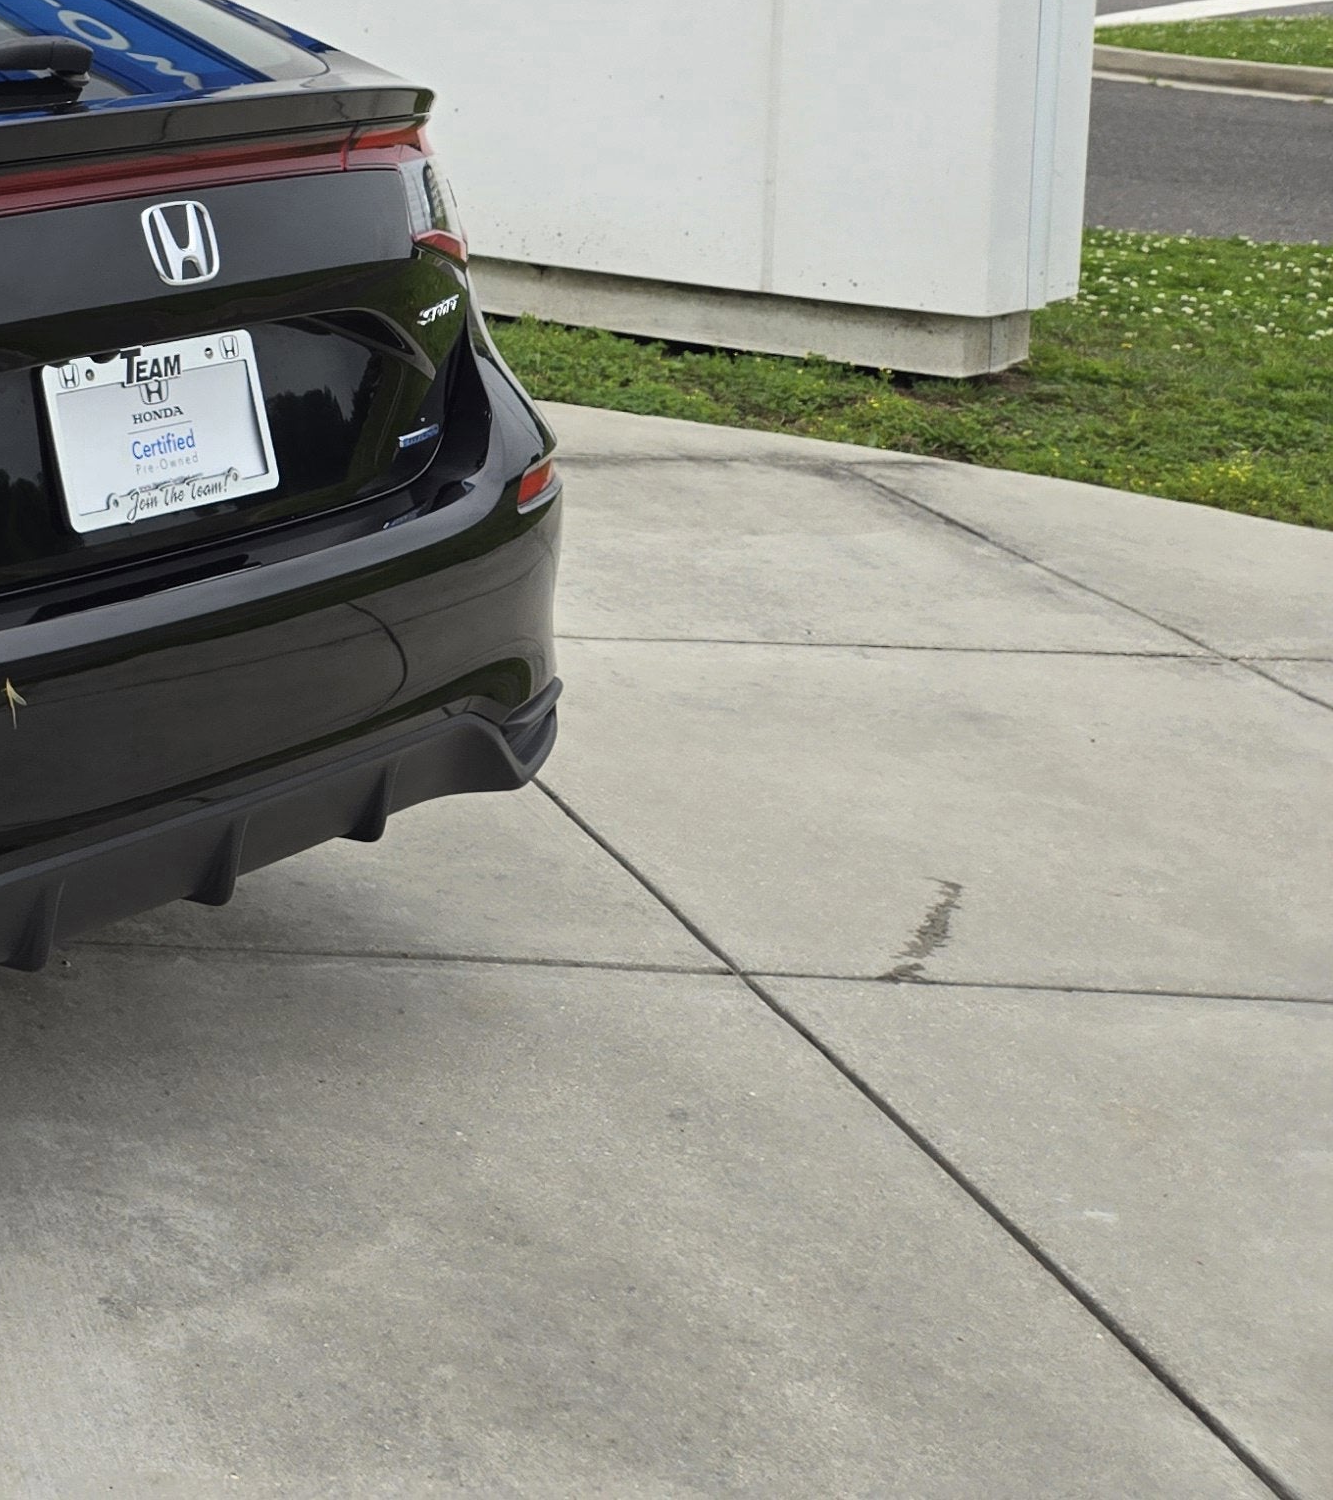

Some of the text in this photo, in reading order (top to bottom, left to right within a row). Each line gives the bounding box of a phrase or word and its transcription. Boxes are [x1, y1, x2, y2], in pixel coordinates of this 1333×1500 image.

[119, 348, 181, 385] TEAM
[132, 405, 184, 425] HONDA
[132, 427, 196, 460] Certified
[135, 451, 199, 475] Pre-Owned
[126, 489, 158, 521] Join
[159, 483, 185, 506] The
